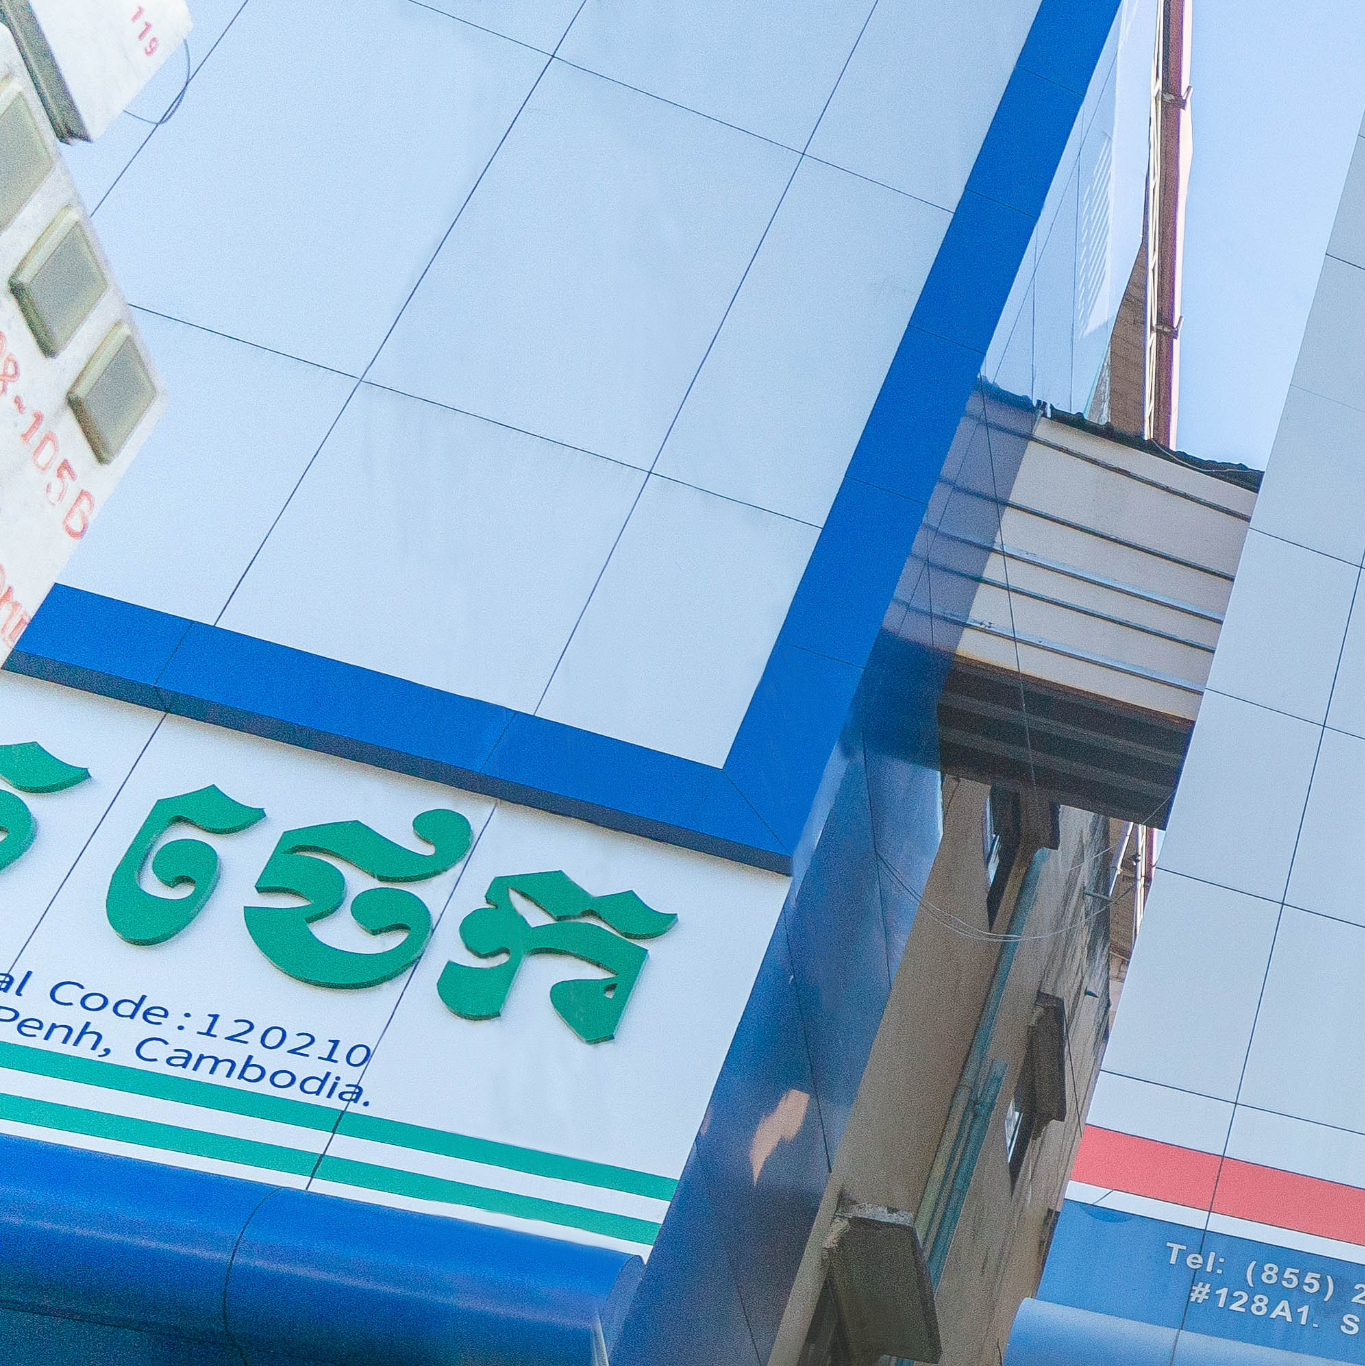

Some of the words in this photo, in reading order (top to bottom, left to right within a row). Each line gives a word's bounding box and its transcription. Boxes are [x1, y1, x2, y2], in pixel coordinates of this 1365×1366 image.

[0, 1005, 112, 1058] Penh,
[135, 1036, 370, 1107] Cambodia.
[1166, 1242, 1225, 1275] Tel:
[1246, 1260, 1335, 1302] (855)
